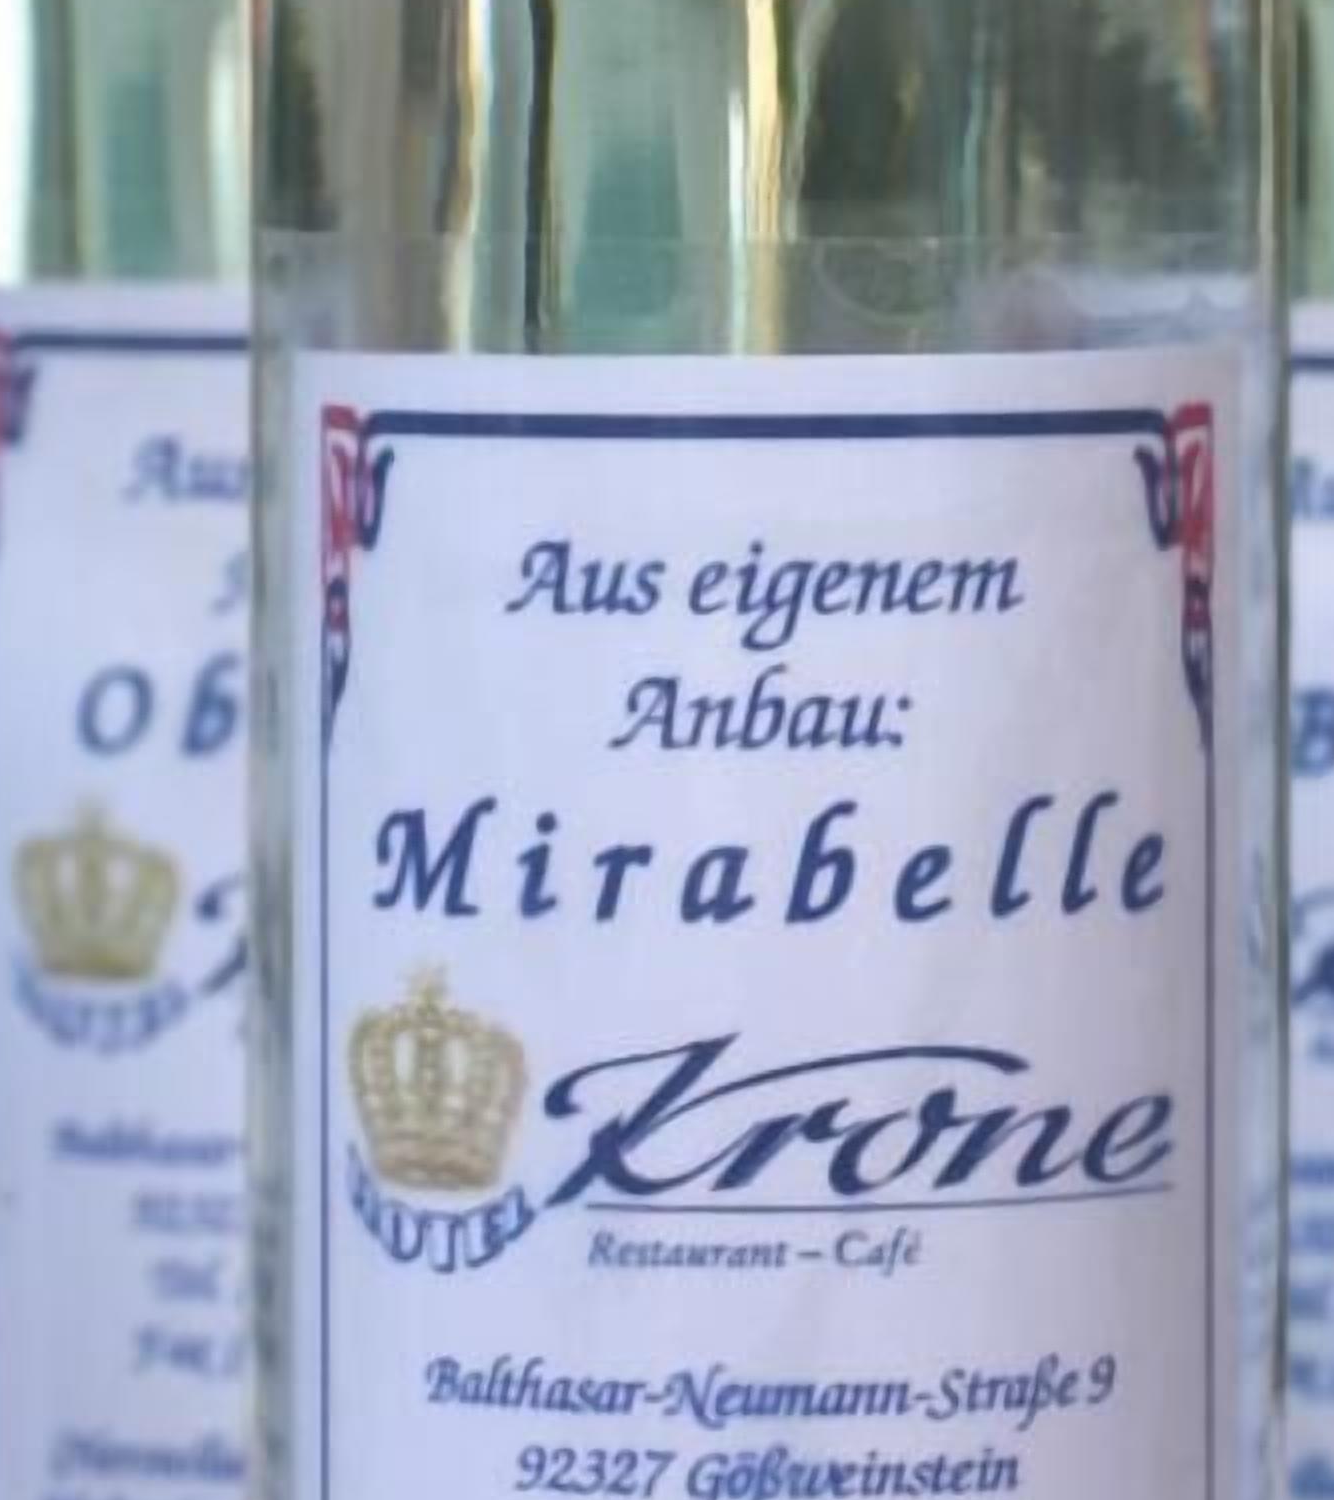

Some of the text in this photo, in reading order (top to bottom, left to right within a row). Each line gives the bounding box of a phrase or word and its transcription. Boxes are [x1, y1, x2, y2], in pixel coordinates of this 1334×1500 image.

[503, 537, 1025, 652] Aus eigenem
[608, 665, 914, 752] Anbau:
[372, 791, 1167, 925] Mirabelle
[540, 1030, 1173, 1208] Krone
[587, 1230, 788, 1269] Restaurant
[835, 1227, 921, 1277] Café
[424, 1355, 1117, 1432] Balthasar-Neumann-Straße 9
[515, 1446, 677, 1497] 92327
